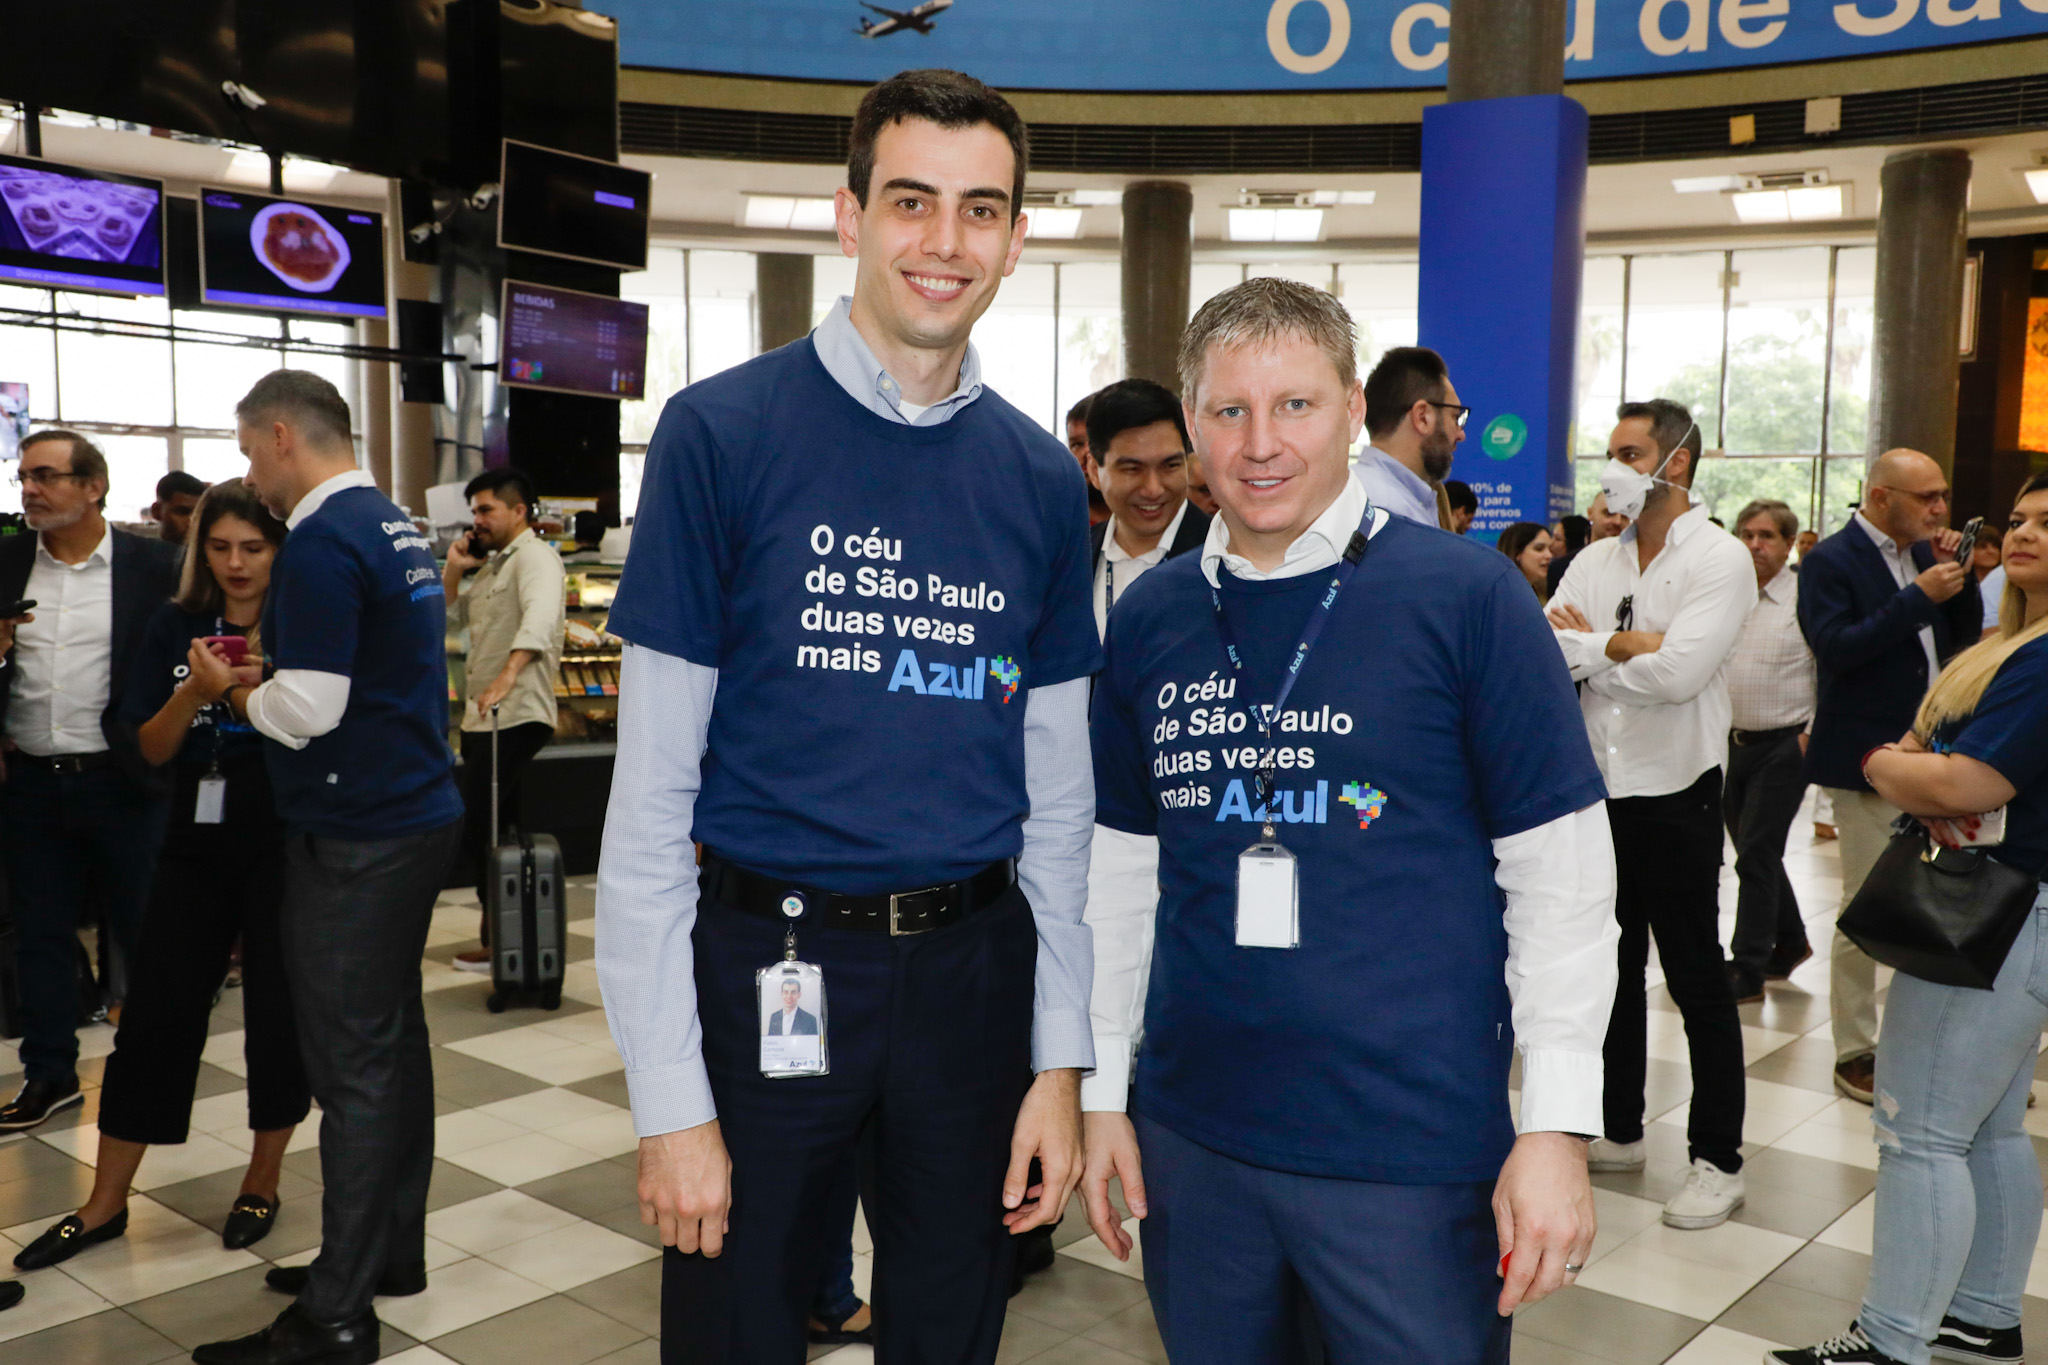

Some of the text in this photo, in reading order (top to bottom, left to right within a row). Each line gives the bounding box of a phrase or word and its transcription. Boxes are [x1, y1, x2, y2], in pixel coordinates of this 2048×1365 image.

[1266, 0, 1350, 74] O
[1484, 496, 1511, 507] para
[1496, 482, 1512, 494] de
[810, 524, 902, 561] O céu
[805, 564, 1006, 612] de São Paulo
[1322, 587, 1338, 609] Azul
[801, 601, 976, 646] duas vezes
[797, 642, 987, 700] mais Azul
[1227, 644, 1240, 663] Azul
[1289, 651, 1305, 674] Azul
[1157, 671, 1236, 710] O céu
[1153, 704, 1354, 744] de São Paulo
[1153, 750, 1212, 778] duas
[1160, 779, 1329, 824] mais Azul
